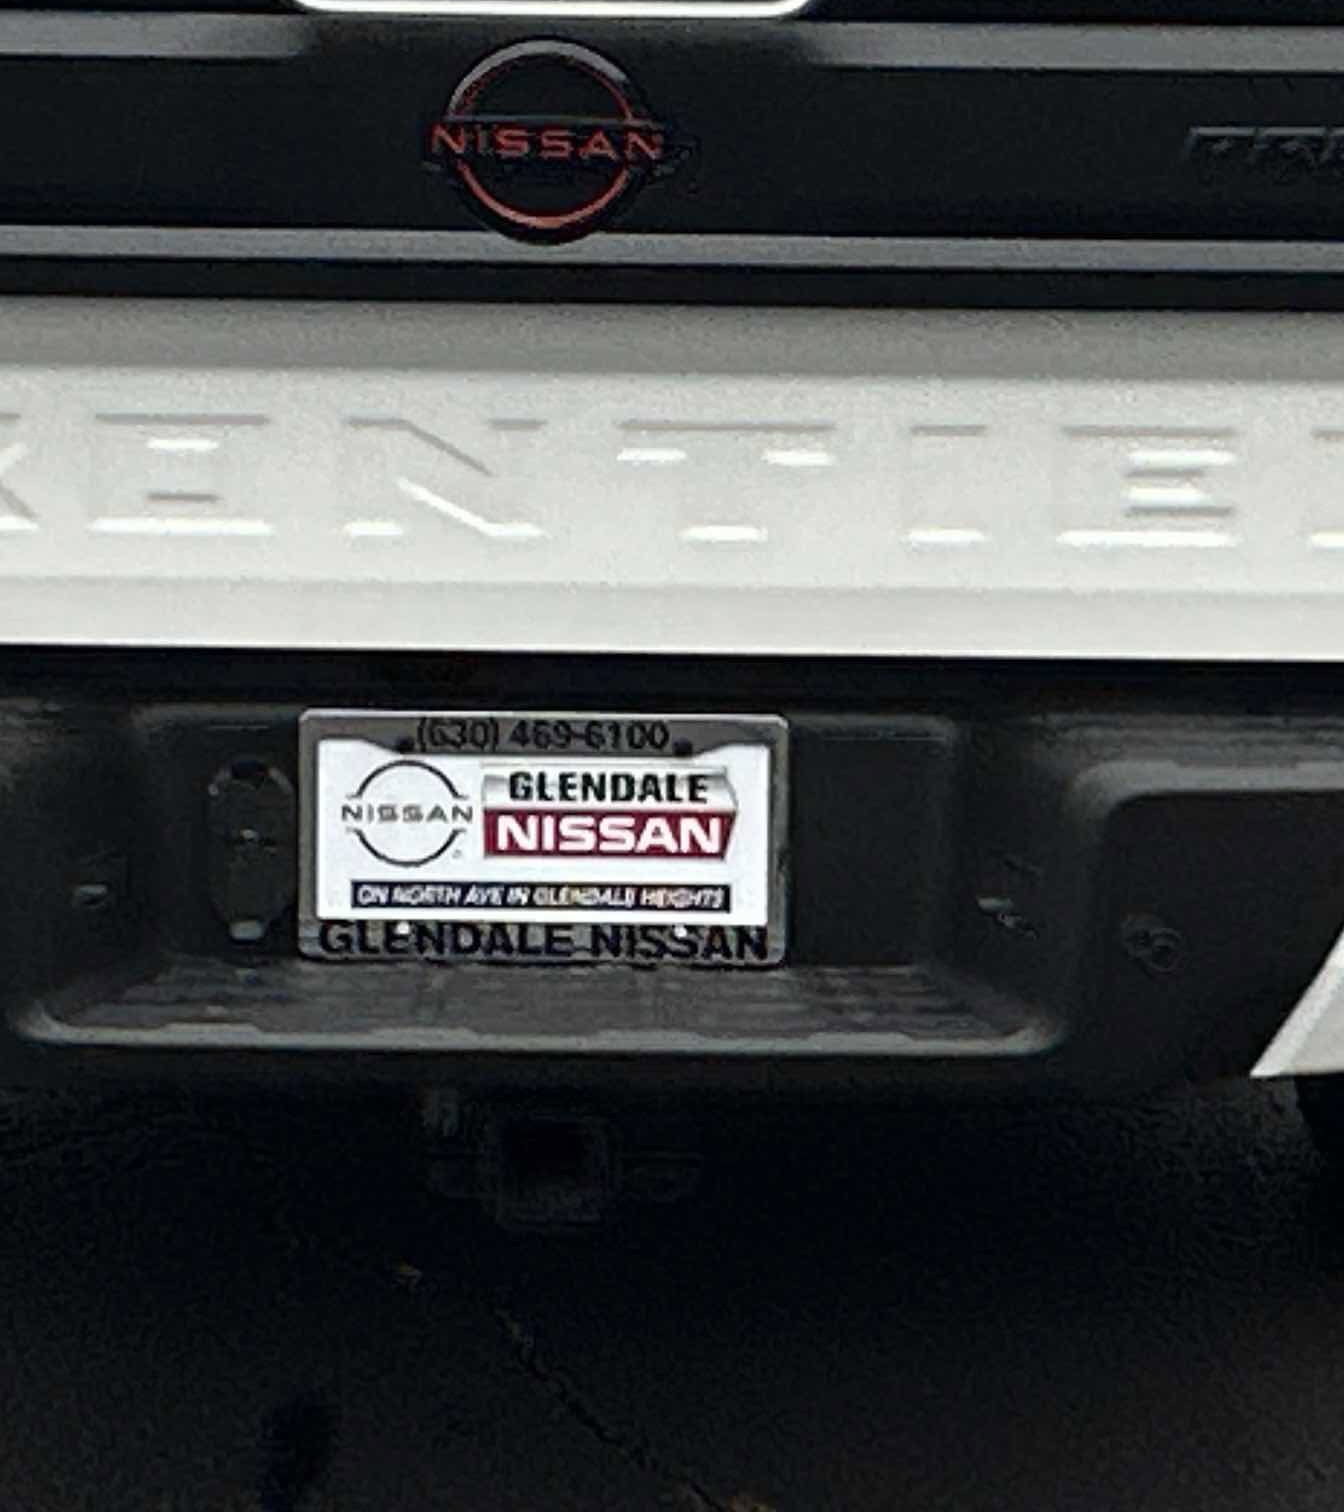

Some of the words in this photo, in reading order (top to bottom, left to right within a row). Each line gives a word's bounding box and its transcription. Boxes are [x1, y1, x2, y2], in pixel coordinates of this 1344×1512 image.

[426, 121, 664, 160] NISSAN
[416, 717, 499, 753] (630)
[509, 719, 671, 750] 469-6100
[508, 770, 709, 803] GLENDALE
[340, 803, 473, 823] NISSAN
[496, 813, 723, 855] NISSAN
[357, 884, 387, 905] ON
[392, 884, 461, 905] NORTH
[318, 919, 574, 957] GLENDALE
[591, 924, 768, 960] NISSAN
